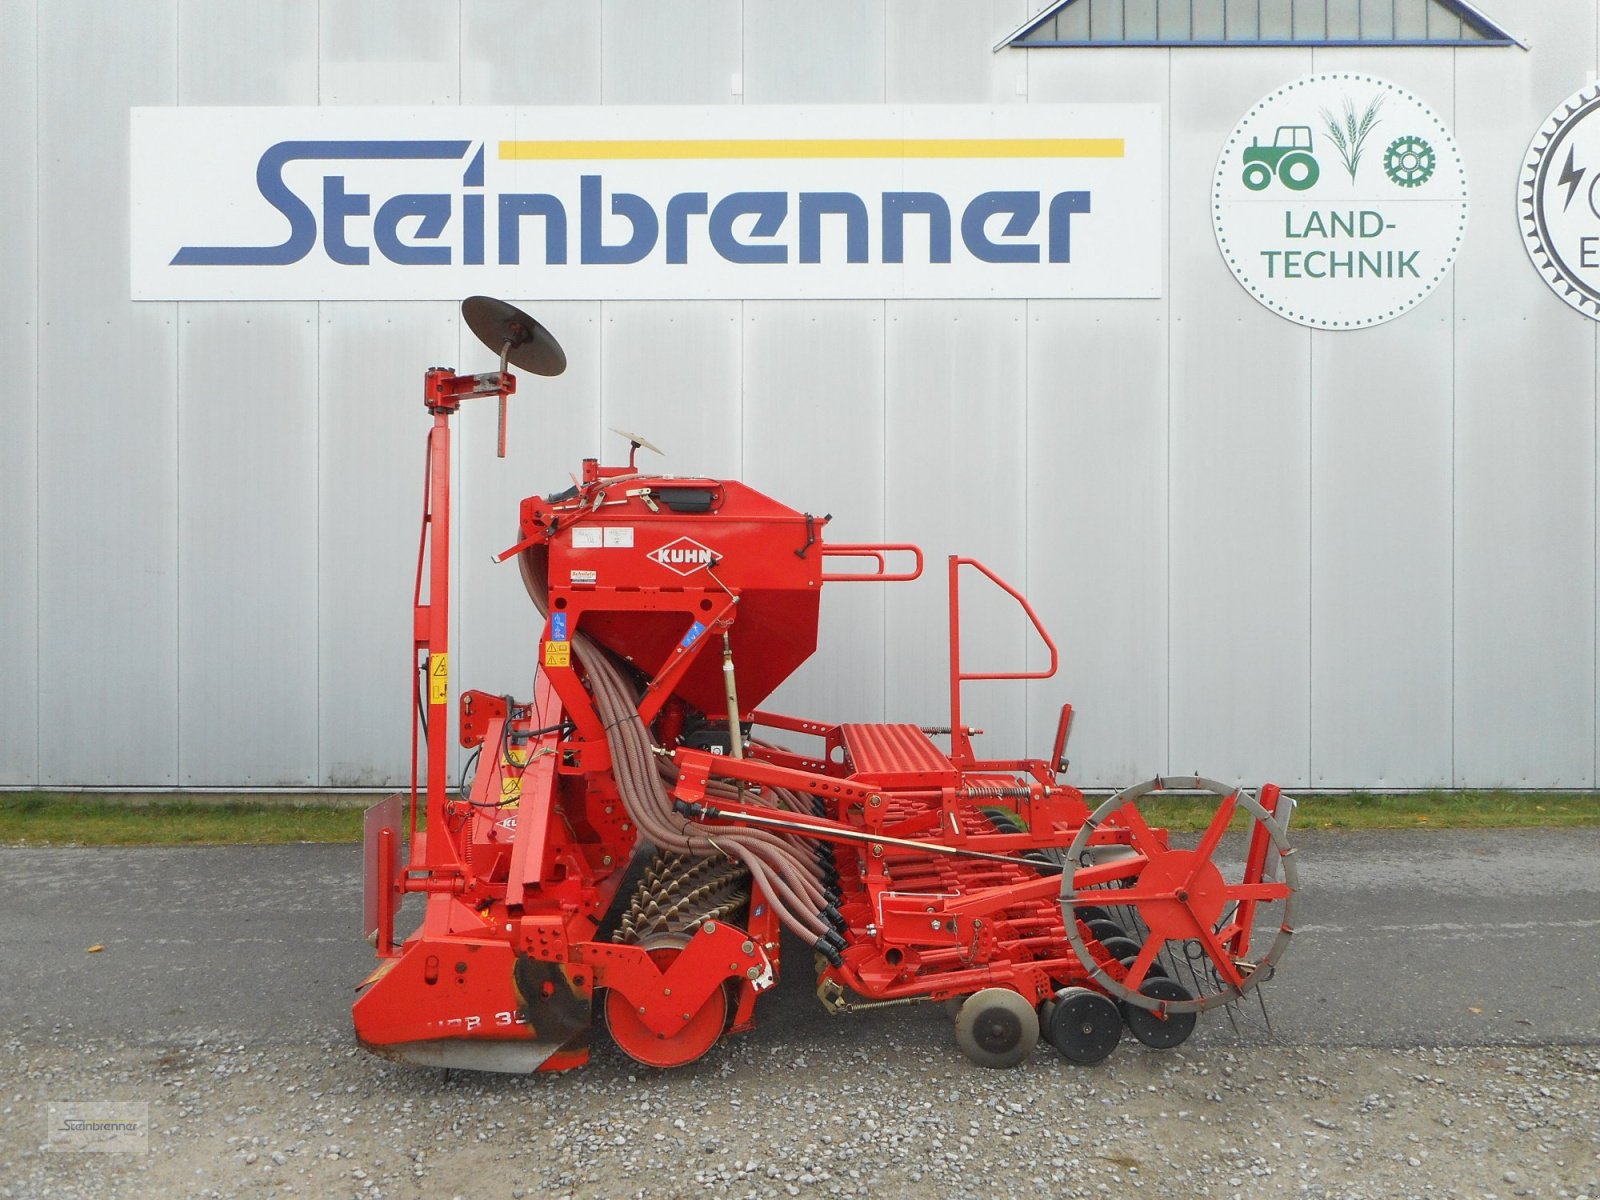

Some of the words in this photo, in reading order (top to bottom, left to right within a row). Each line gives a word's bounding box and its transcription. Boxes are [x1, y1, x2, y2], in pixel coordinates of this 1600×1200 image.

[168, 140, 1091, 266] Steinbrenner
[1285, 210, 1396, 238] LAND-
[1260, 251, 1421, 278] TECHNIK
[658, 549, 711, 563] KUHN
